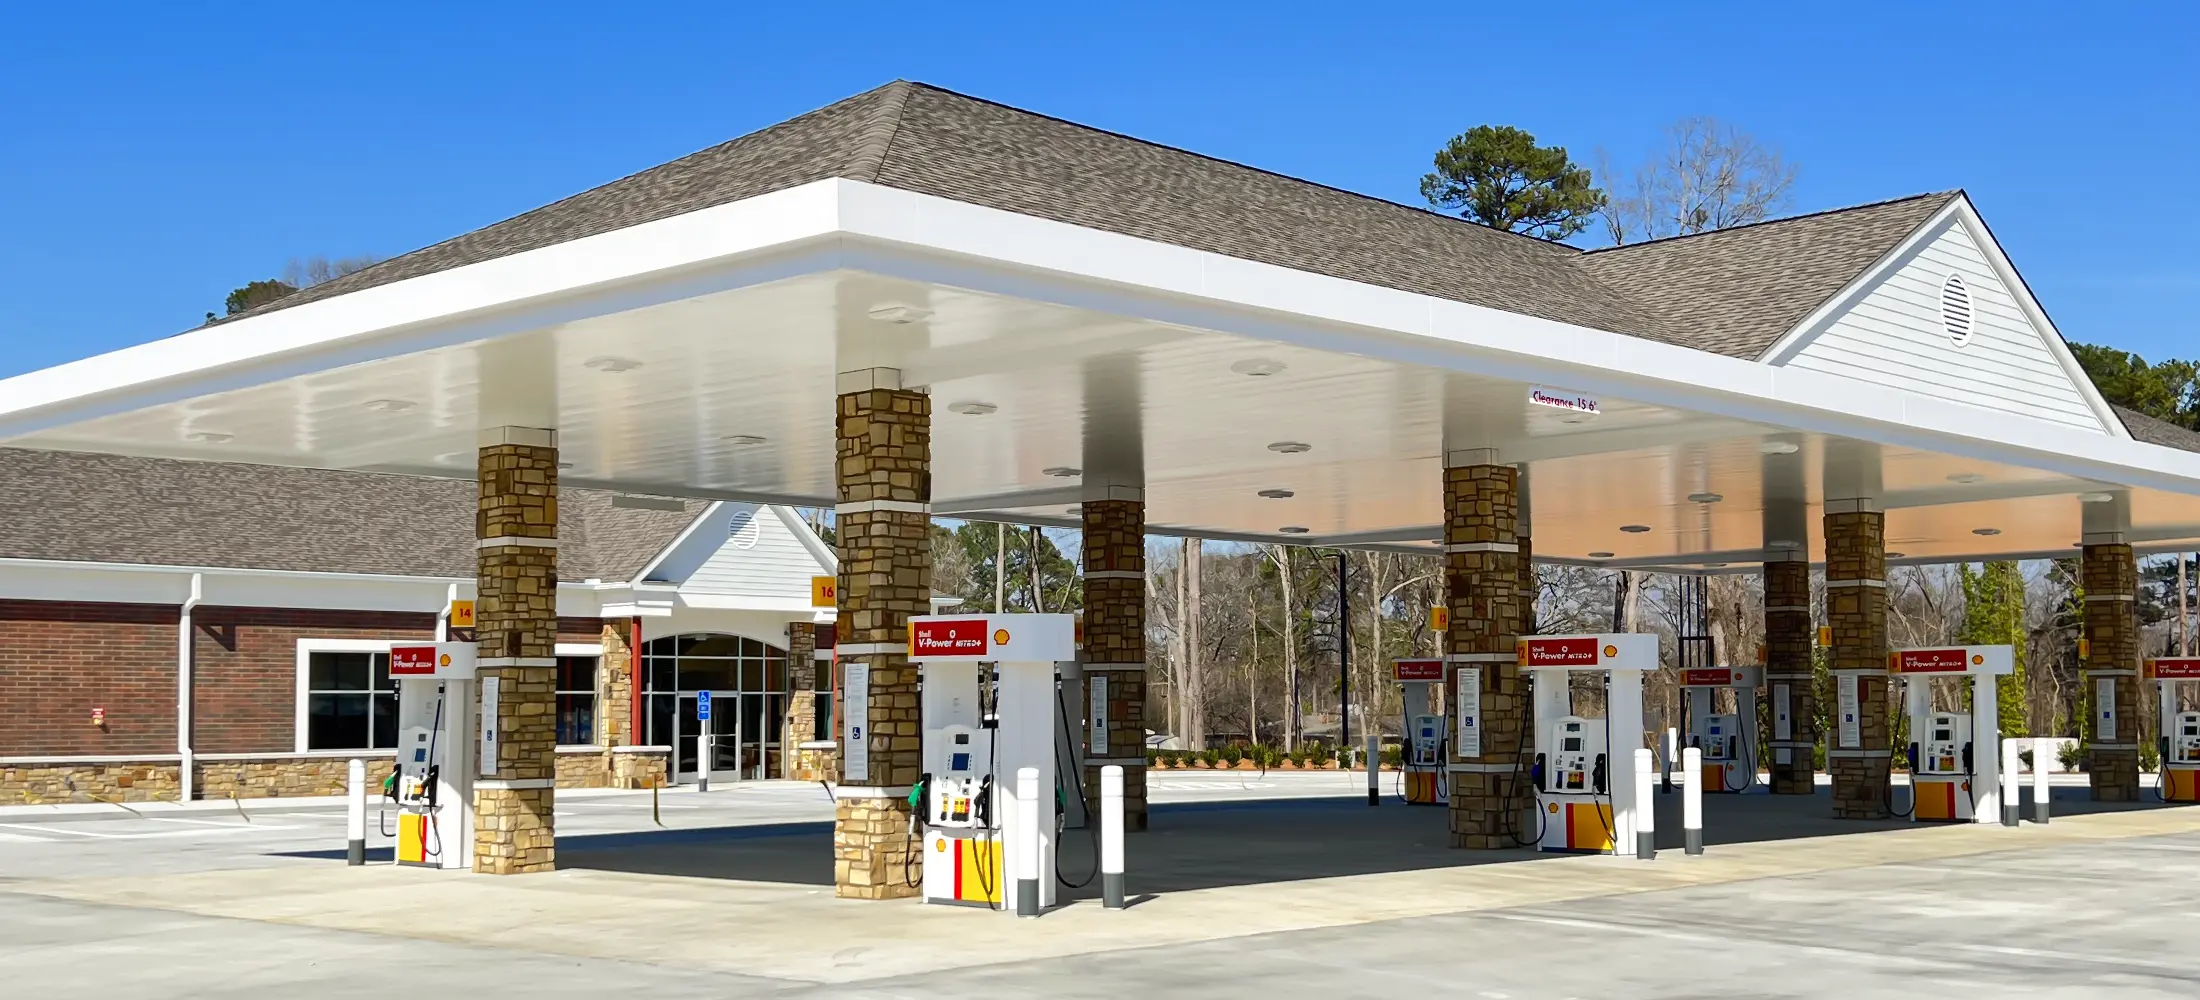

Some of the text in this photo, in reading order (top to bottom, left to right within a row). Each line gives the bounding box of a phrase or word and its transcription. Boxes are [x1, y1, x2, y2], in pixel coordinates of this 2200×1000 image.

[1533, 391, 1573, 408] Clearance
[821, 586, 834, 598] 16
[460, 608, 471, 618] 14
[918, 630, 931, 638] Shell
[918, 639, 952, 648] V-Power
